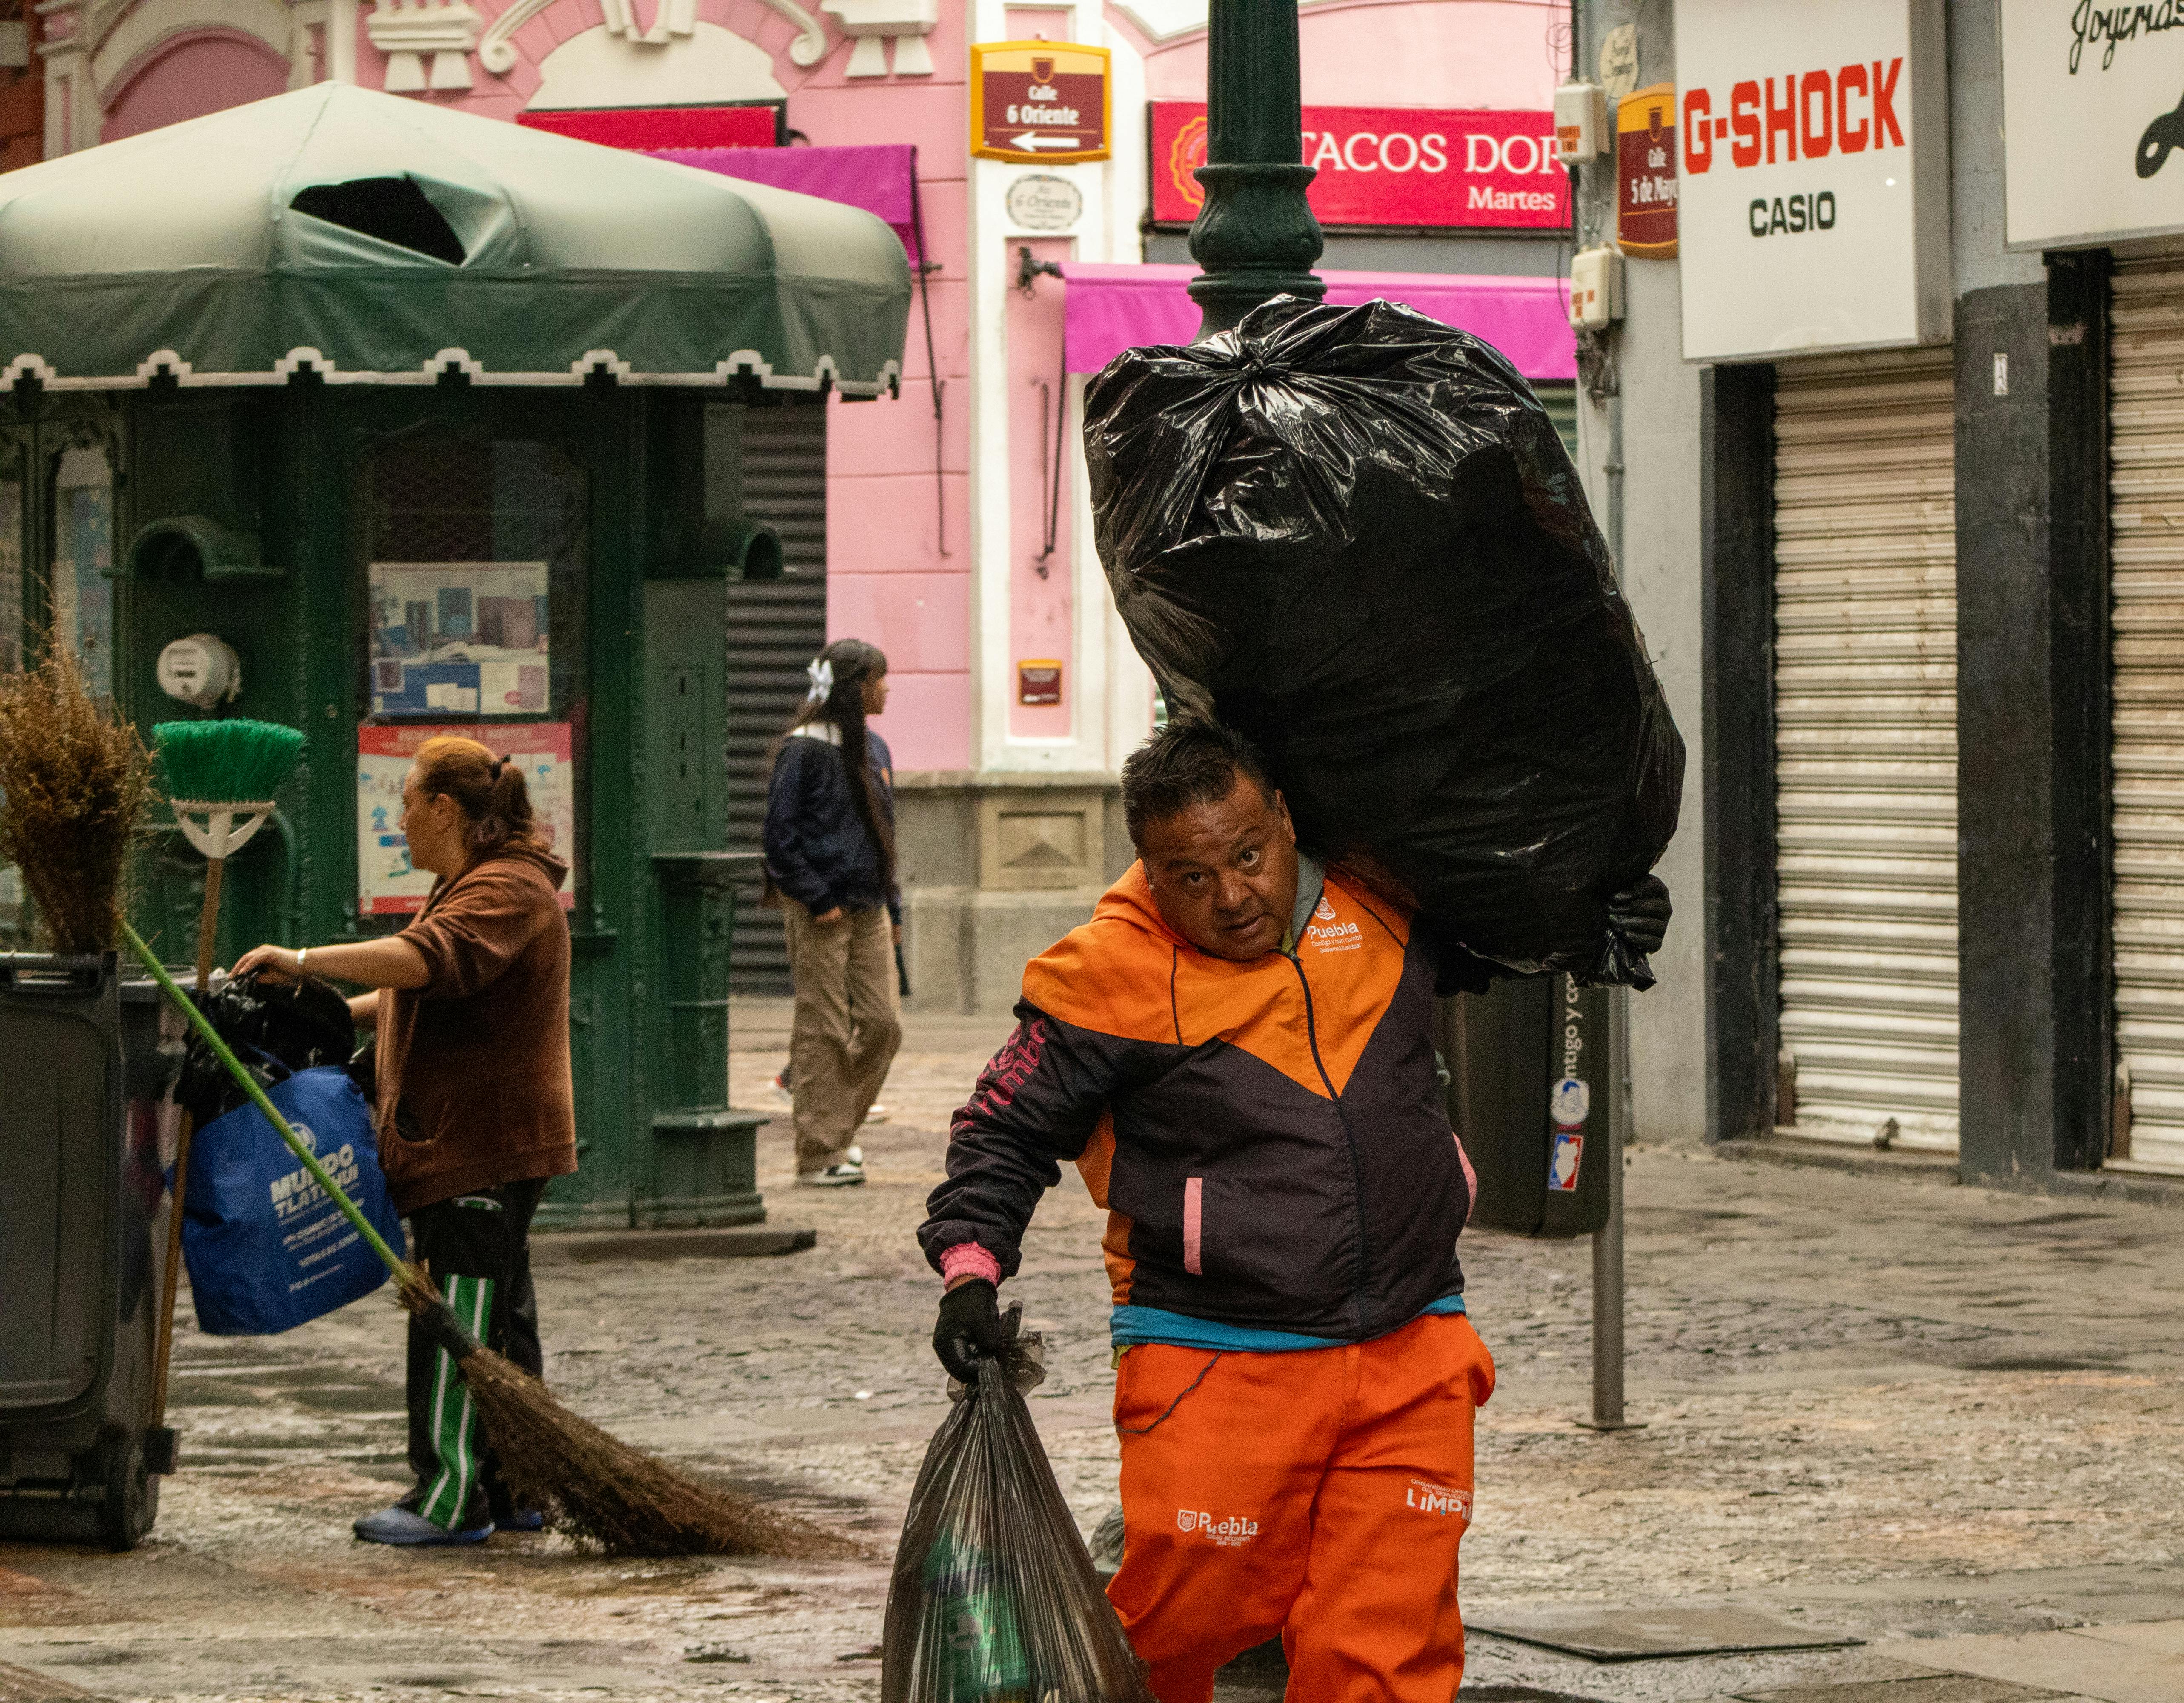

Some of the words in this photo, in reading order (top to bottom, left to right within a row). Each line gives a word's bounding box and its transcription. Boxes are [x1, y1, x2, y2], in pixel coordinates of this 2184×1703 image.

[1028, 85, 1058, 101] Calle
[1006, 106, 1018, 125] 6
[1021, 103, 1080, 125] Oriente
[1683, 57, 1905, 175] G-SHOCK
[1467, 186, 1556, 211] Martes
[1631, 178, 1639, 204] 5
[1640, 175, 1653, 203] de
[1749, 190, 1836, 238] CASIO
[1307, 922, 1359, 939] Puebla
[1566, 1008, 1583, 1022] y
[1563, 1025, 1582, 1078] ntigo
[1411, 1479, 1451, 1492] ORGANISMO
[1198, 1512, 1258, 1536] Puebla
